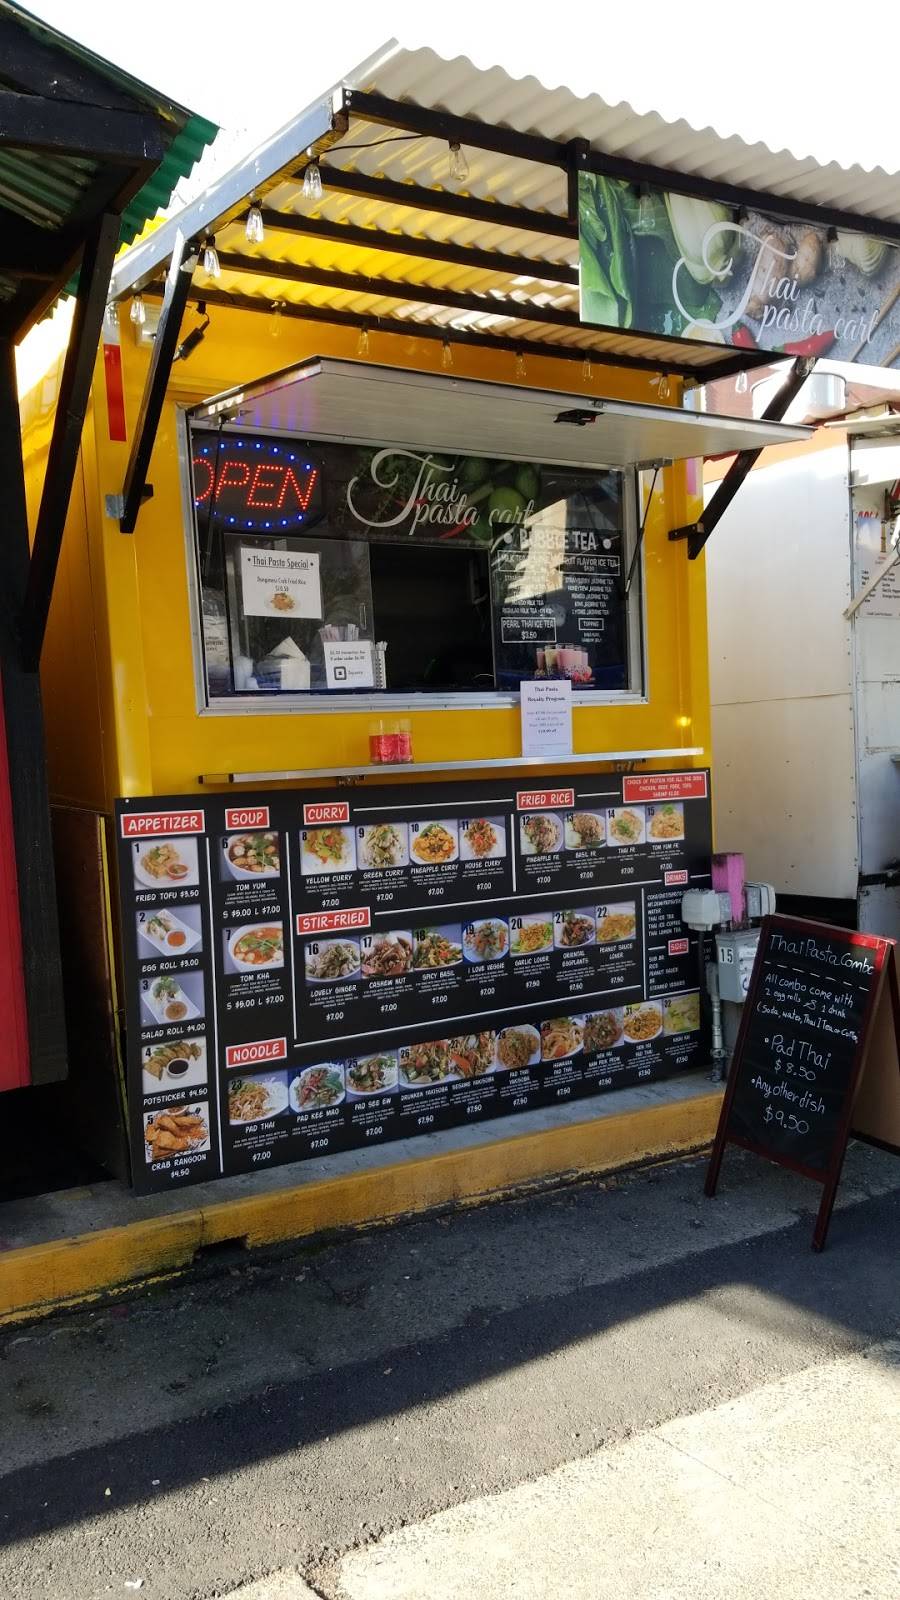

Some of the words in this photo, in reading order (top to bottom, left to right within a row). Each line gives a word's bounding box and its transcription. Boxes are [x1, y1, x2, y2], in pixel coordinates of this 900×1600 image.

[673, 222, 800, 330] Thai
[756, 298, 826, 342] pasta
[192, 458, 318, 510] OPEN
[347, 448, 460, 528] Thai
[409, 493, 481, 536] pasta
[573, 531, 596, 550] TEA
[253, 556, 267, 566] Thai
[269, 557, 285, 566] Pasta
[287, 559, 308, 569] Special
[576, 558, 597, 566] FLAVOR
[503, 620, 520, 628] PEARL
[524, 620, 534, 628] THAI
[543, 620, 554, 628] TEA
[521, 631, 537, 640] $3.50
[521, 795, 549, 806] FRIED
[551, 792, 570, 804] RICE
[232, 812, 263, 825] SOUP
[308, 807, 344, 820] CURRY
[608, 809, 615, 819] 14
[128, 815, 199, 832] APPETIZER
[462, 821, 469, 830] 11
[522, 816, 530, 825] 12
[359, 827, 364, 838] 9
[411, 823, 419, 832] 10
[302, 832, 307, 841] 8
[135, 843, 140, 853] 1
[223, 838, 228, 848] 6
[410, 865, 438, 874] PINEAPPLE
[465, 861, 483, 869] HOUSE
[485, 860, 501, 868] CURRY
[660, 863, 672, 871] $7.00
[363, 871, 383, 879] GREEN
[385, 869, 404, 877] CURRY
[580, 871, 594, 879] $7.00
[621, 867, 634, 875] $7.00
[306, 875, 330, 885] YELLOW
[332, 874, 352, 882] CURRY
[537, 876, 551, 884] $7.00
[252, 882, 266, 890] YUM
[477, 882, 492, 891] $7.00
[136, 893, 156, 903] FRIED
[160, 892, 178, 900] TOFU
[180, 890, 199, 898] $3.50
[428, 887, 444, 896] $7.00
[322, 898, 339, 907] $7.00
[377, 893, 394, 902] $7.00
[223, 911, 228, 919] S
[232, 908, 252, 917] $5.00
[262, 905, 280, 914] $7.00
[597, 907, 607, 918] 22
[140, 913, 145, 922] 2
[303, 913, 365, 930] STIR-FRIED
[556, 913, 565, 923] 21
[511, 919, 522, 930] 20
[226, 930, 231, 940] 7
[416, 930, 425, 941] 18
[363, 937, 372, 947] 17
[307, 944, 318, 955] 16
[599, 945, 617, 953] PEANUT
[618, 942, 633, 950] SAUCE
[770, 935, 804, 955] Thai
[805, 939, 840, 965] Pasta
[721, 948, 733, 963] 15
[142, 965, 156, 973] EGG
[160, 962, 178, 970] ROLL
[180, 959, 199, 967] $3.00
[515, 957, 532, 966] GARLIC
[240, 975, 255, 983] TOM
[257, 972, 270, 981] KHA
[143, 980, 148, 990] 3
[369, 980, 393, 989] CASHEW
[395, 977, 406, 985] NUT
[310, 988, 333, 998] LOVELY
[335, 985, 357, 994] GINGER
[480, 987, 495, 996] $7.00
[765, 973, 778, 984] All
[779, 978, 807, 991] combo
[809, 987, 833, 1000] come
[835, 993, 854, 1008] with
[227, 1002, 232, 1010] S
[235, 999, 255, 1009] $5.00
[258, 998, 263, 1006] L
[265, 995, 284, 1004] $7.00
[432, 995, 448, 1004] $7.00
[773, 991, 785, 1001] egg
[828, 1004, 846, 1018] drink
[380, 1003, 397, 1012] $7.00
[326, 1012, 344, 1021] $7.00
[141, 1030, 164, 1040] SALAD
[167, 1026, 184, 1035] ROLL
[187, 1023, 205, 1033] $4.00
[146, 1047, 151, 1056] 4
[233, 1043, 280, 1062] NOODLE
[400, 1049, 410, 1058] 26
[771, 1035, 794, 1057] Pad
[799, 1041, 832, 1070] Thai
[348, 1058, 358, 1068] 25
[231, 1080, 242, 1090] 23
[143, 1091, 186, 1106] POTSTICKER
[755, 1076, 772, 1098] Any
[773, 1081, 799, 1102] other
[799, 1091, 825, 1114] dish
[355, 1101, 366, 1110] PAD
[368, 1099, 380, 1108] SEE
[148, 1115, 153, 1125] 5
[296, 1112, 309, 1122] PAD
[311, 1111, 323, 1120] KEE
[326, 1108, 339, 1117] MAO
[764, 1104, 809, 1134] $9.50
[245, 1123, 258, 1133] PAD
[260, 1121, 275, 1130] THAI
[366, 1127, 383, 1136] $7.00
[311, 1139, 328, 1149] $7.00
[151, 1161, 171, 1171] CRAB
[174, 1153, 207, 1166] RANGOON
[252, 1152, 271, 1162] $7.00
